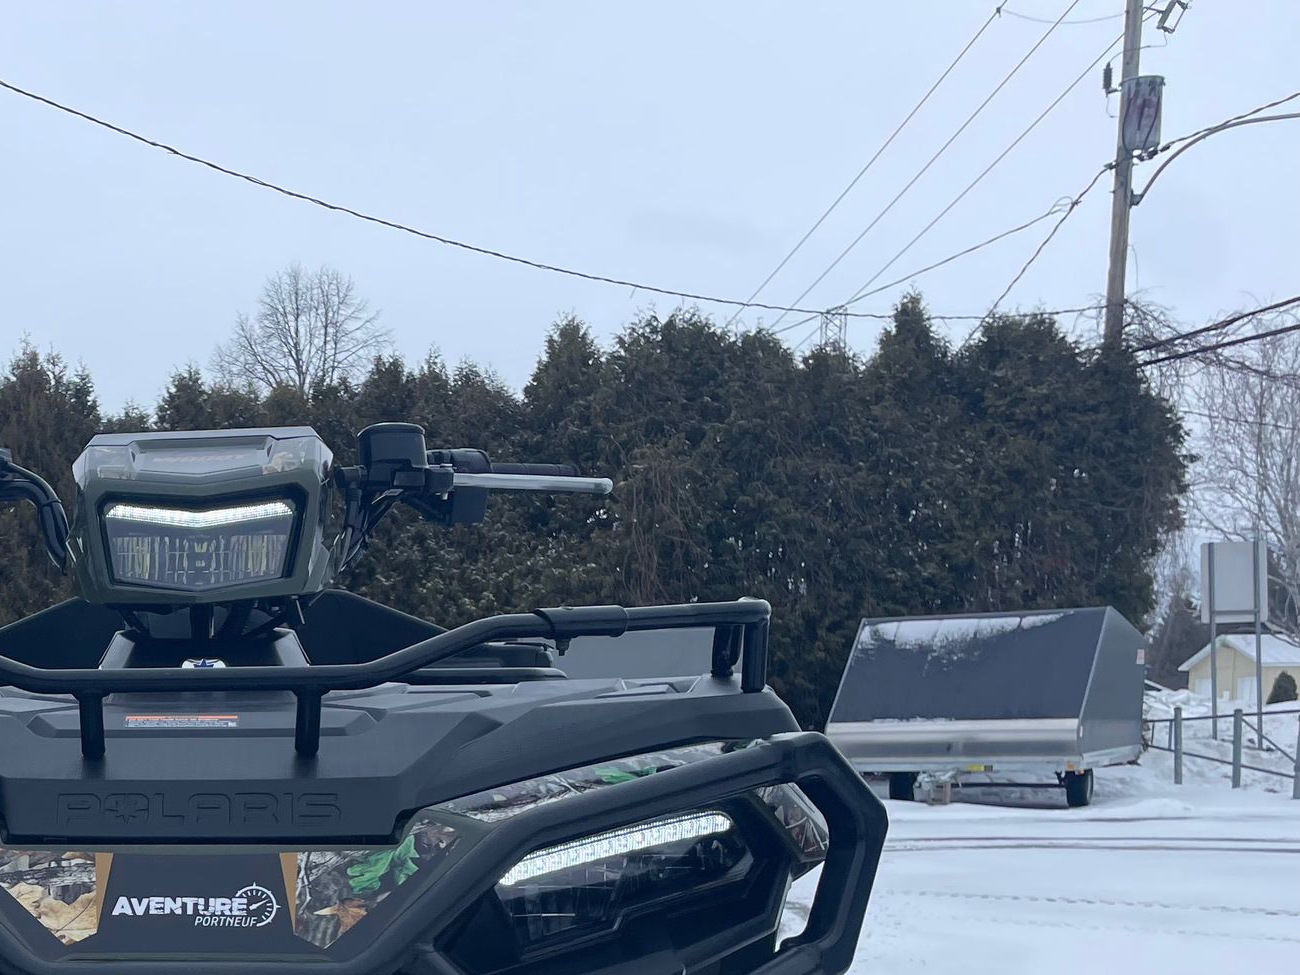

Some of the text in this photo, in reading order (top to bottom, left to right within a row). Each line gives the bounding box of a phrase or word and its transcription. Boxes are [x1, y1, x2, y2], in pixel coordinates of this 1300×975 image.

[57, 792, 341, 825] POLARIS
[112, 896, 248, 916] AVENTURE
[194, 916, 258, 927] PORTNEUF
